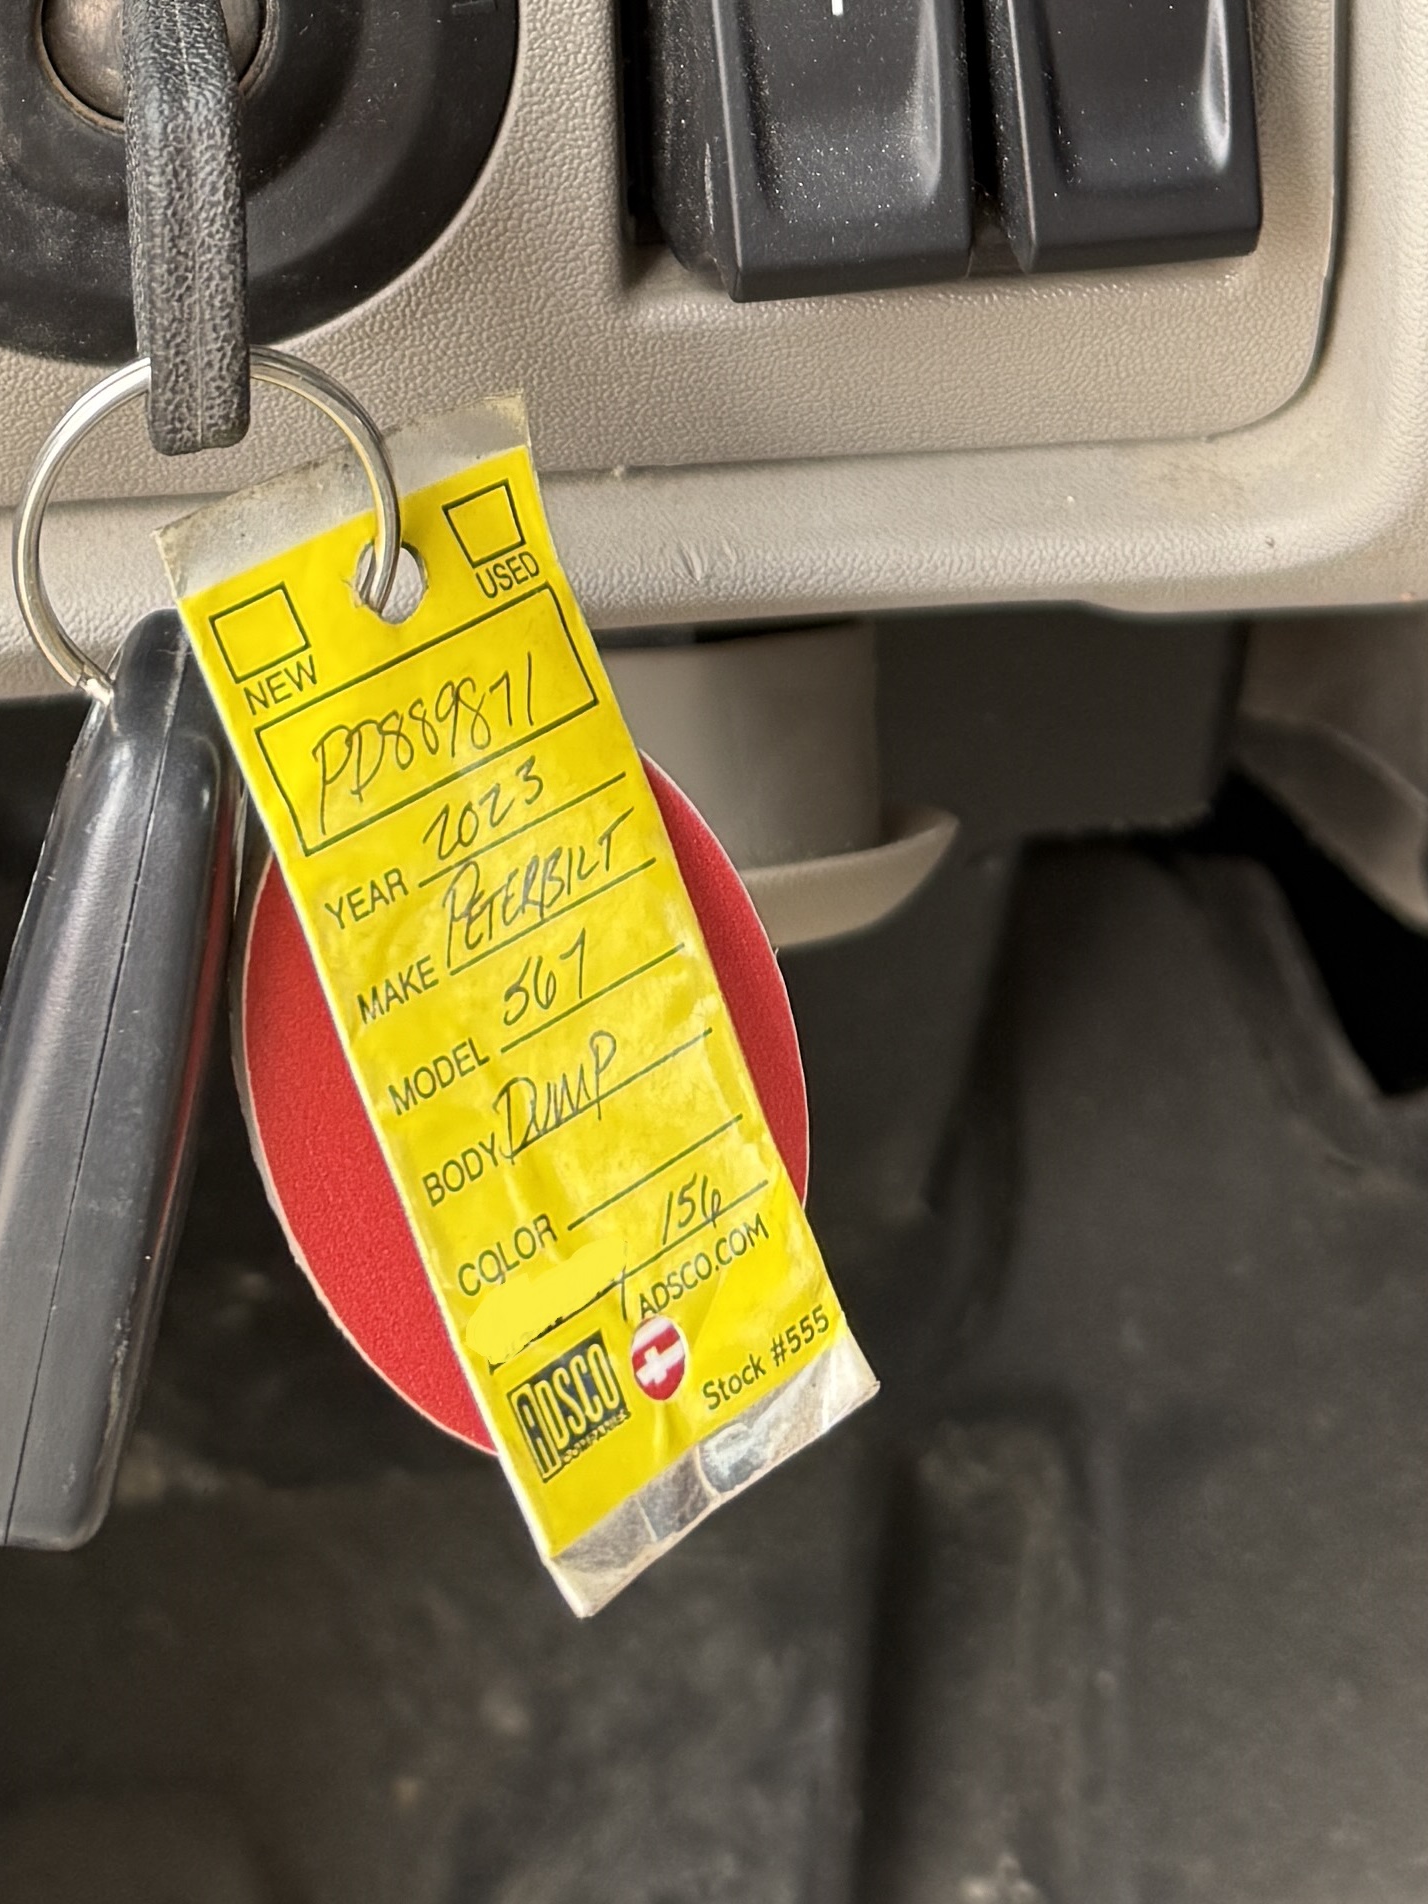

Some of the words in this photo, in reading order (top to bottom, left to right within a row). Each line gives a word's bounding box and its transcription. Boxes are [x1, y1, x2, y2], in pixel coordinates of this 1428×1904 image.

[475, 550, 541, 600] USED
[243, 654, 318, 715] NEW
[311, 651, 536, 836] PD889871
[422, 754, 544, 860] 2023
[324, 868, 410, 930] YEAR
[356, 954, 440, 1025] MAKE
[503, 928, 586, 1026] 567
[387, 1037, 491, 1116] MODEL
[422, 1132, 500, 1207] BODY
[457, 1213, 559, 1297] COLOR
[638, 1212, 770, 1319] ADSCO.COM
[702, 1352, 767, 1411] Stock
[769, 1303, 831, 1369] #555
[512, 1342, 621, 1480] ADSCO
